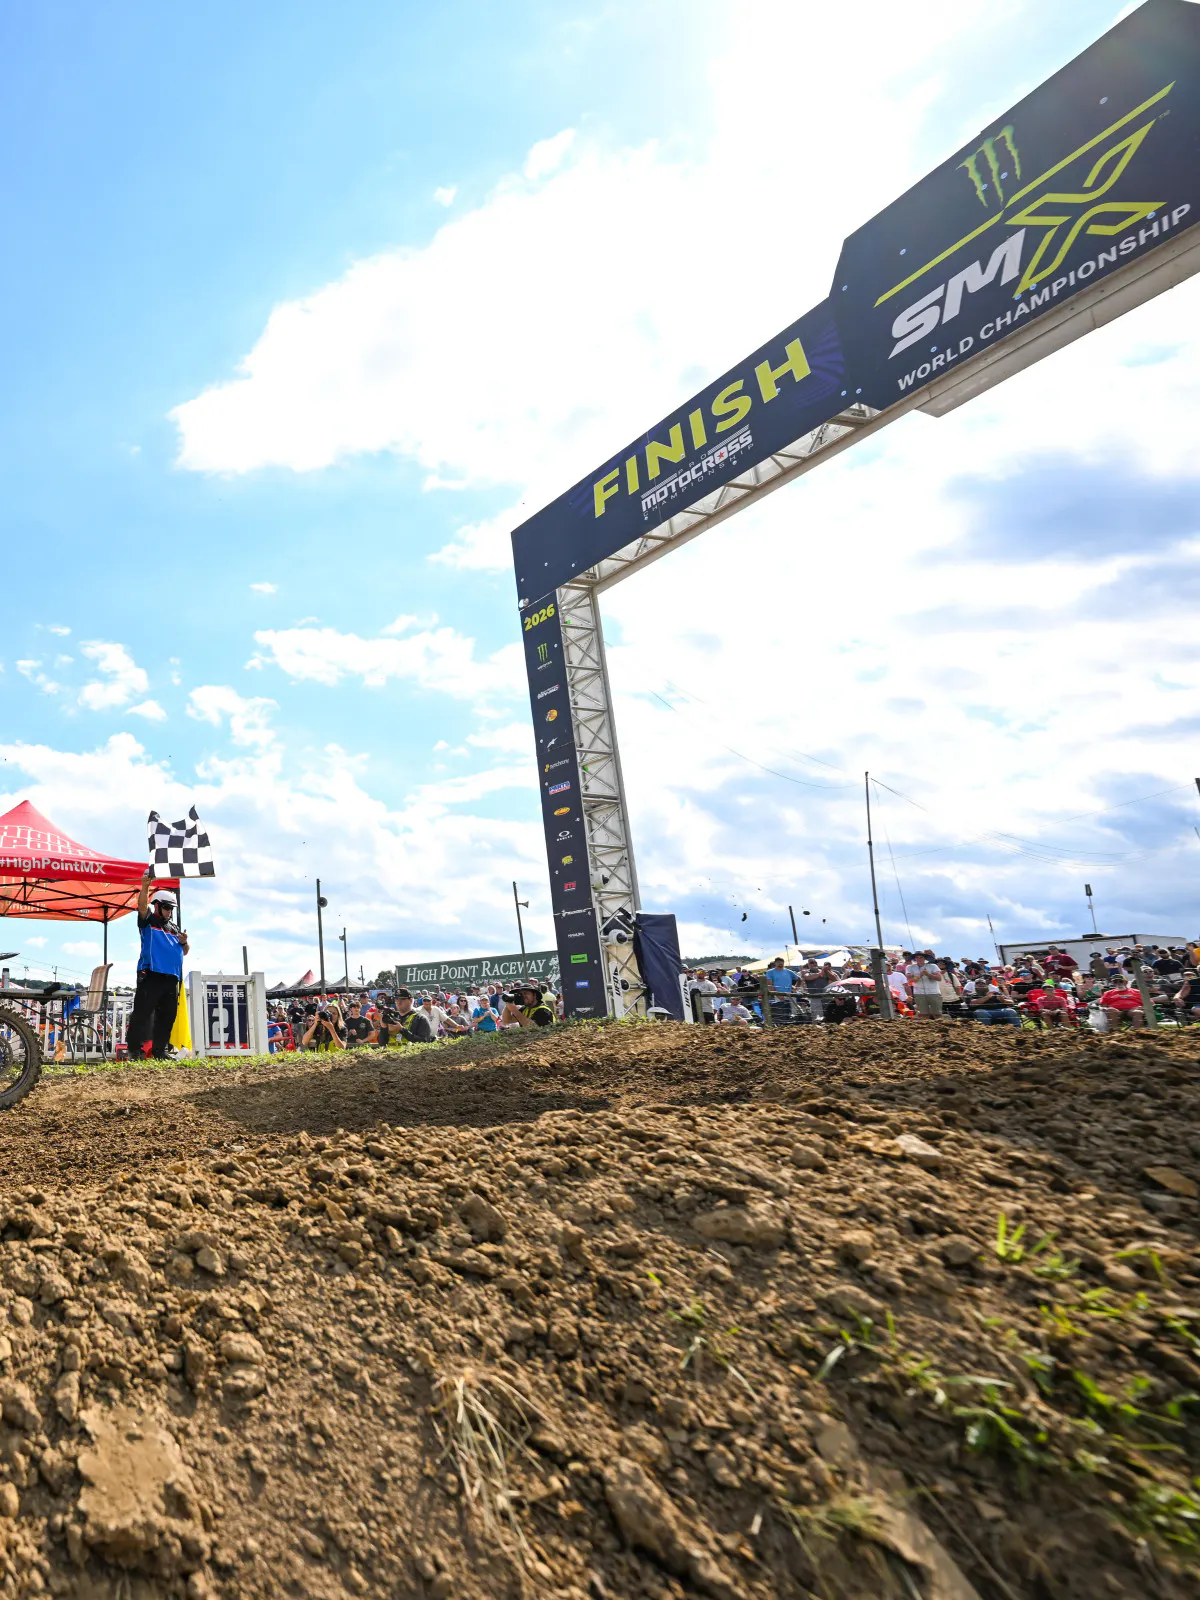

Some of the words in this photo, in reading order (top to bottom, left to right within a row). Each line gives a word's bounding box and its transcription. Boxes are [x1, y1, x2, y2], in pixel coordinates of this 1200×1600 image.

[888, 119, 1167, 360] SMX
[897, 336, 974, 391] WORLD
[980, 203, 1191, 341] CHAMPIONSHIP
[593, 337, 812, 518] FINISH
[677, 453, 707, 475] PRO
[641, 430, 753, 512] MOTOCROSS
[643, 443, 754, 517] CHAMPIONSHIP
[523, 603, 556, 631] 2026
[406, 967, 437, 983] HIGH
[440, 964, 479, 980] POINT
[481, 959, 547, 977] RACEWAY
